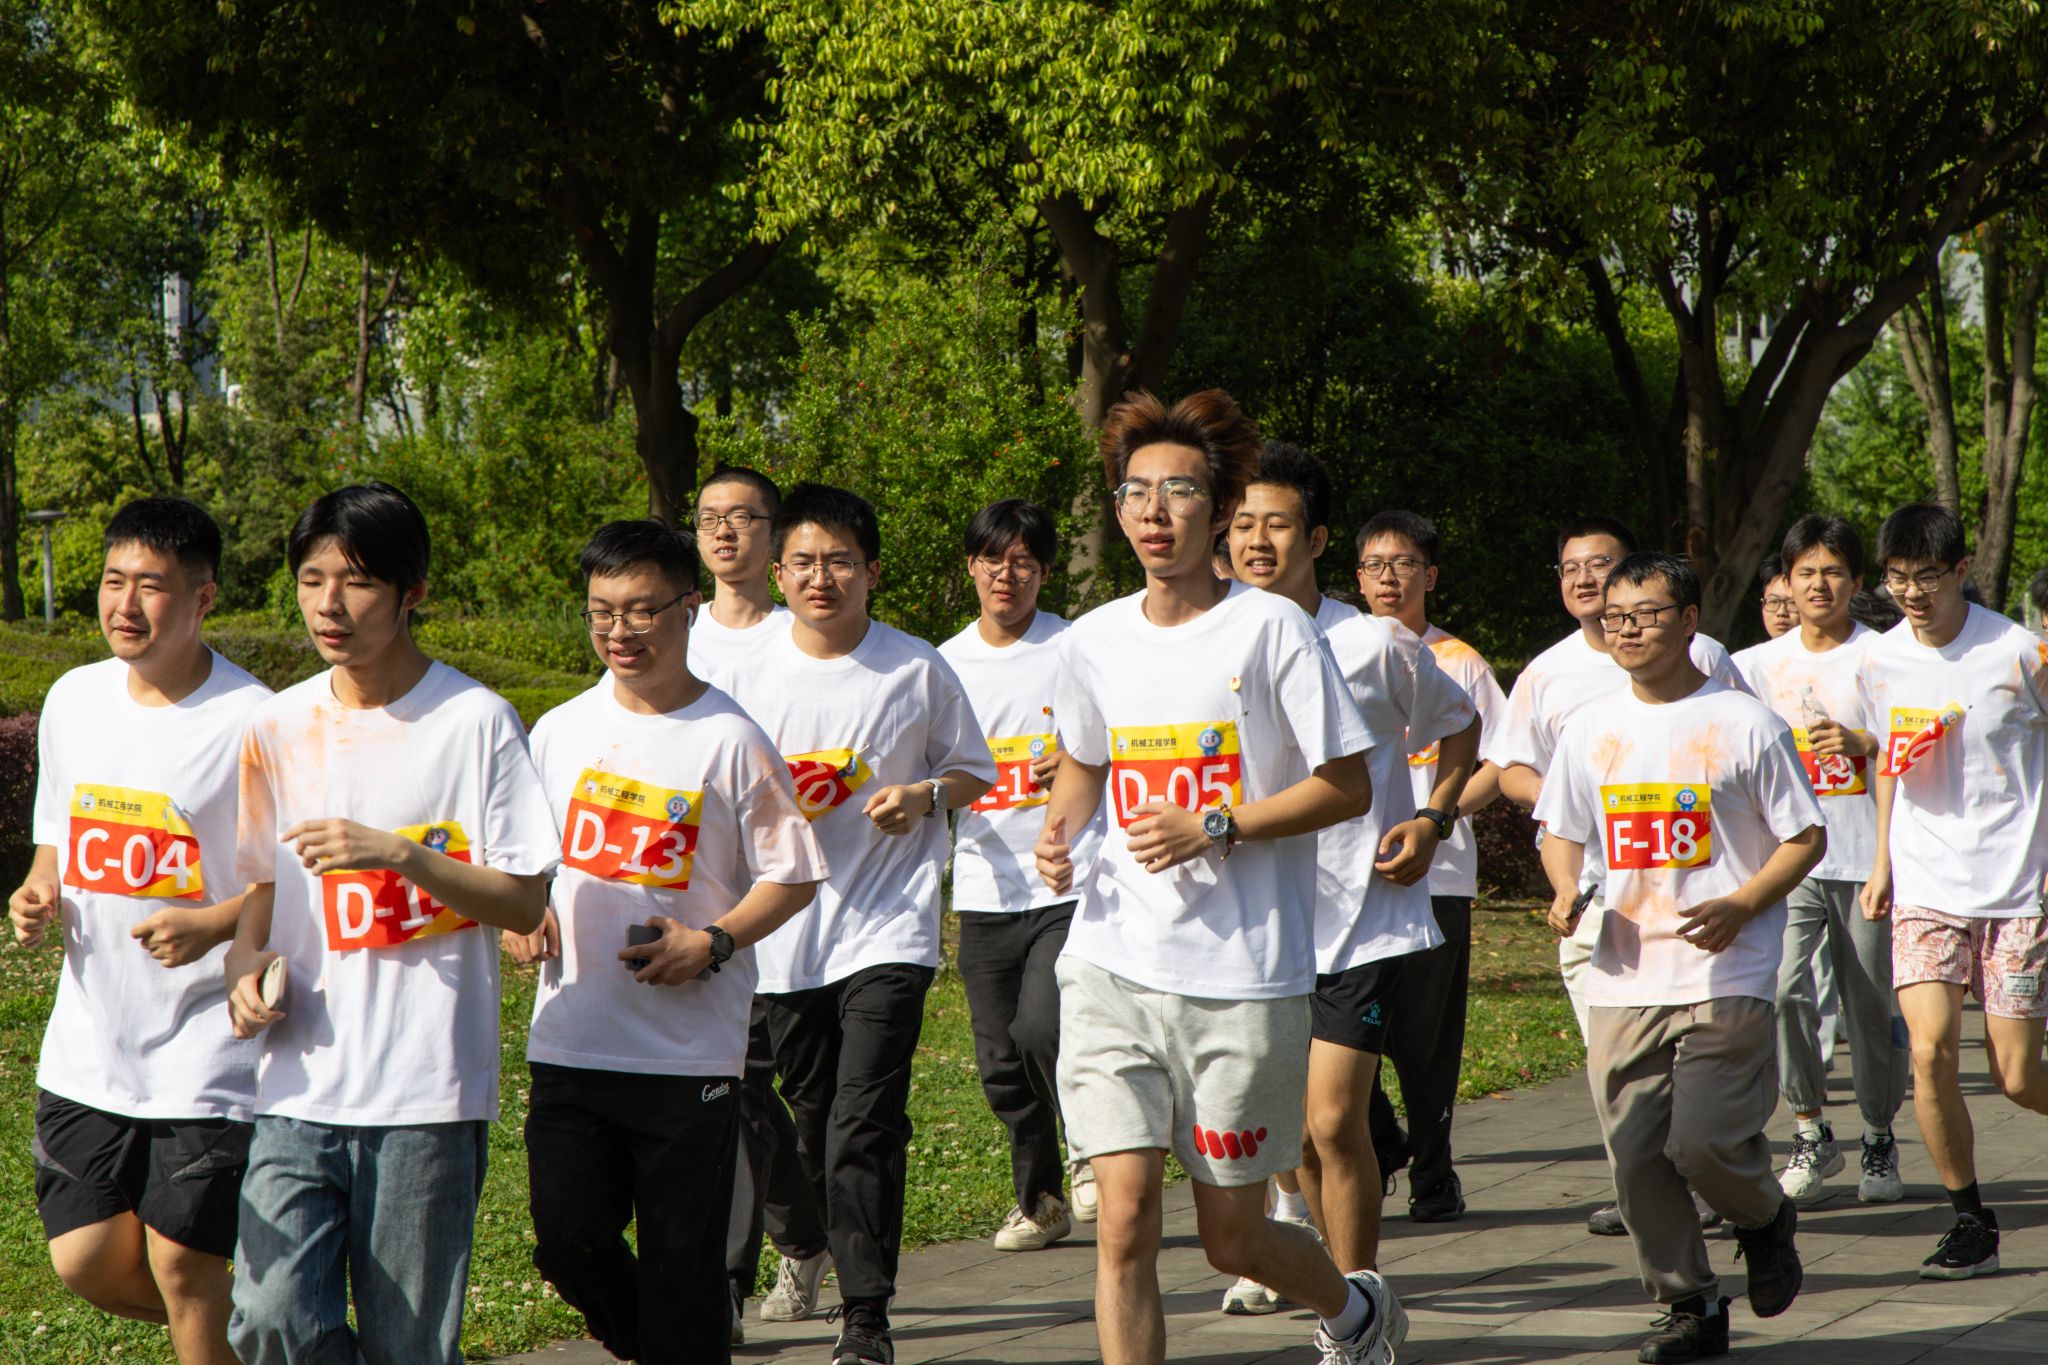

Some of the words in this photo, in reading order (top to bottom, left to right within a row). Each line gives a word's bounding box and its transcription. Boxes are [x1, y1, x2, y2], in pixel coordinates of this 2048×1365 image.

[1131, 737, 1177, 748] 机械工程学院
[98, 798, 143, 813] 机械工程学院
[600, 785, 646, 804] 机械工程学院
[1118, 763, 1234, 820] D-05
[1620, 793, 1661, 802] 机械工程学院
[77, 827, 193, 889] C-04
[569, 808, 688, 879] D-13
[1613, 818, 1698, 862] F-18
[336, 875, 446, 939] D-1
